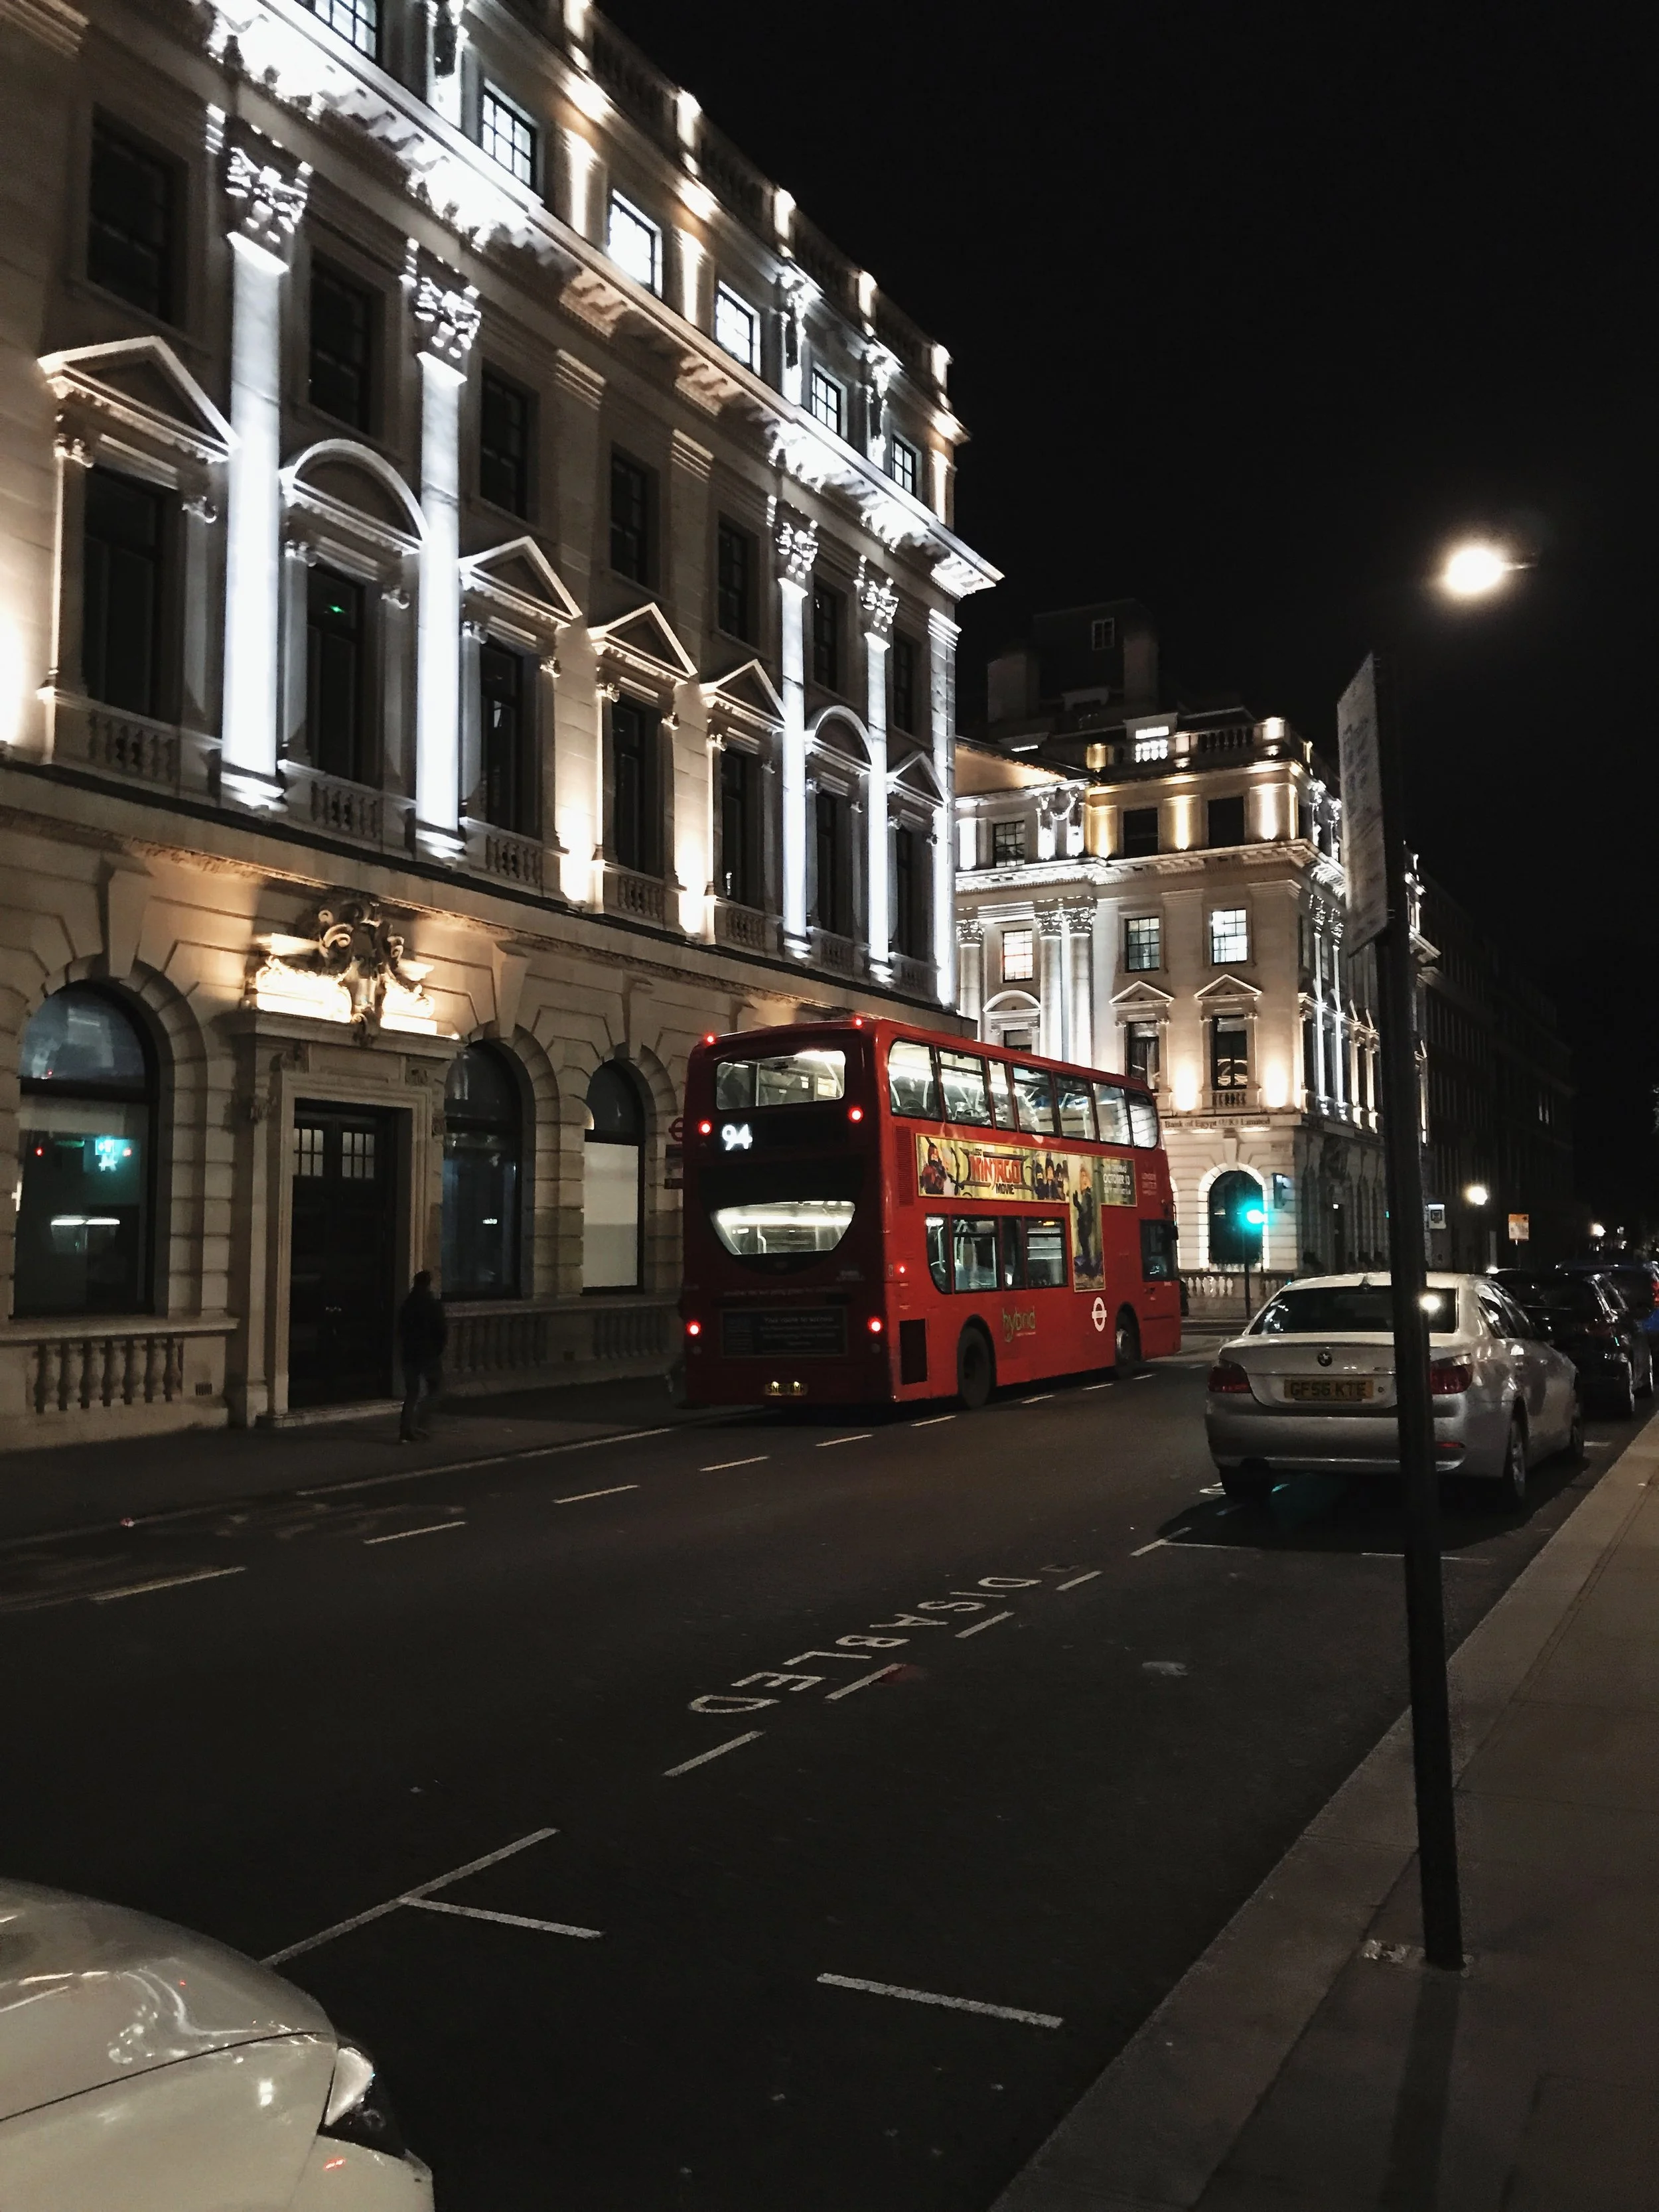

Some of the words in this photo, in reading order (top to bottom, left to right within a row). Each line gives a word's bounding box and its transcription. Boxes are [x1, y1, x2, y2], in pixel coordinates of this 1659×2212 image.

[722, 1123, 753, 1151] 94
[1195, 1120, 1217, 1130] Egypt
[1240, 1117, 1270, 1126] Limited
[969, 1155, 1021, 1188] NINJAGO
[995, 1183, 1015, 1195] MOVIE
[1002, 1305, 1036, 1343] hybrid
[688, 1577, 1043, 1714] DISABLED
